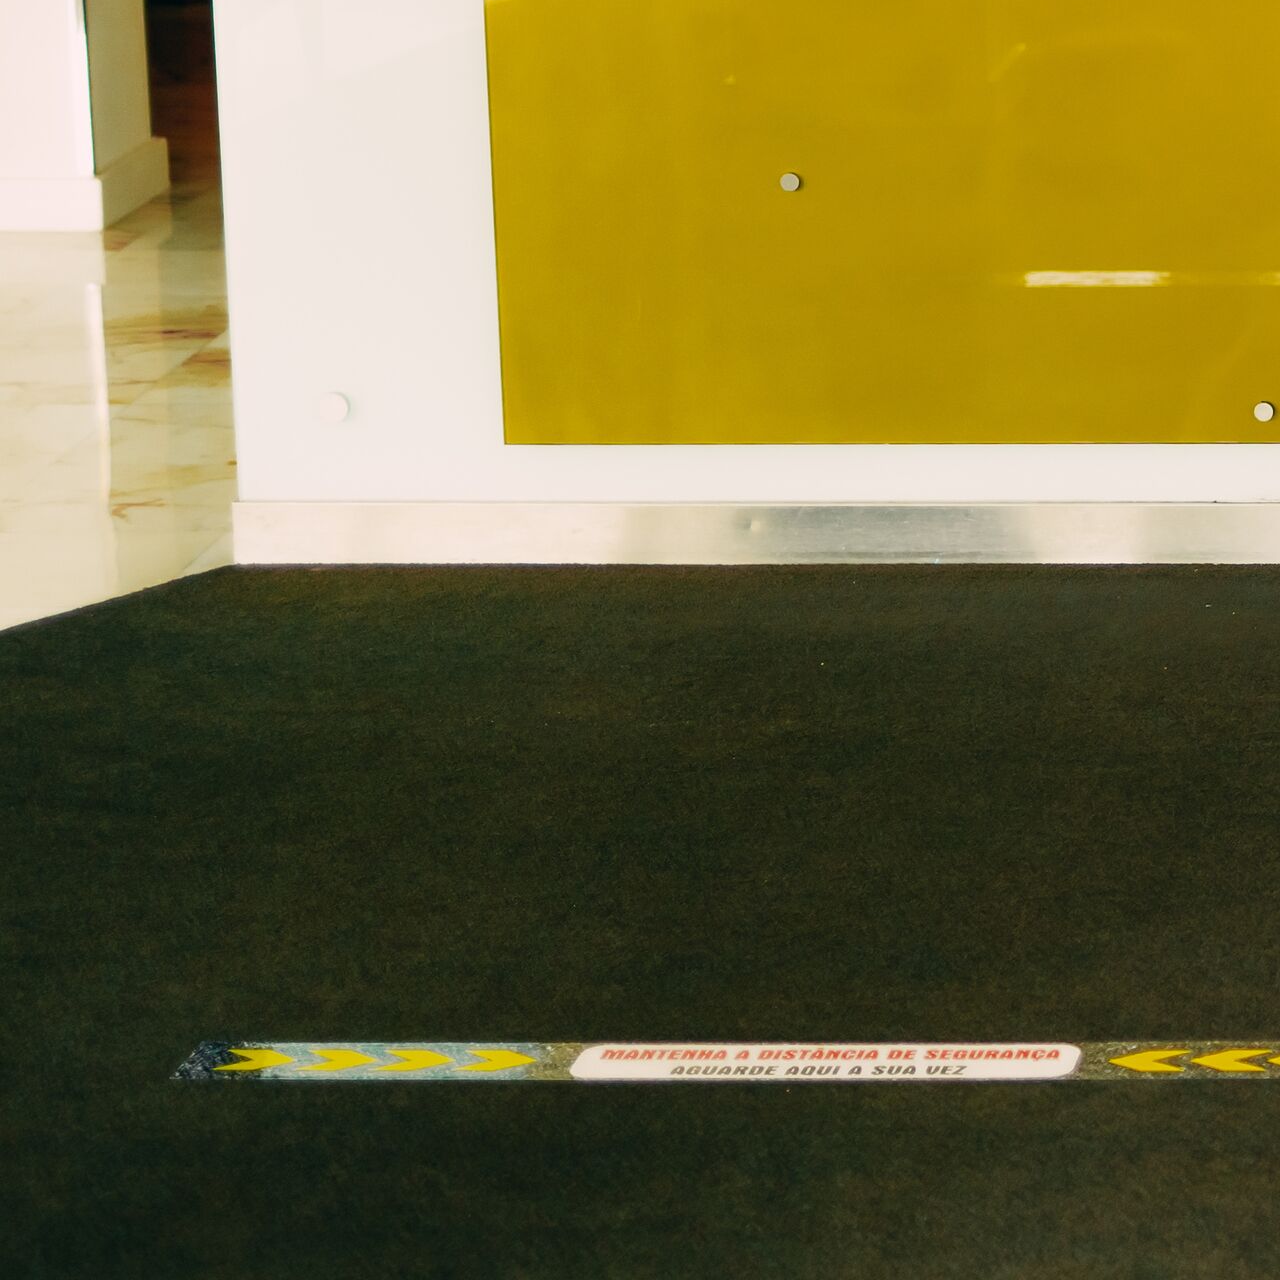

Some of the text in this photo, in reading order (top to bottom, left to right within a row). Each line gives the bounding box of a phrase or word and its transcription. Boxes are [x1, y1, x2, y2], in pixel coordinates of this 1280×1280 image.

[600, 1047, 1060, 1061] MANTENHA A DISTÂNCIA DE SEGURANÇA
[670, 1065, 967, 1076] AGUARDE AQUI A SUA VEZ
